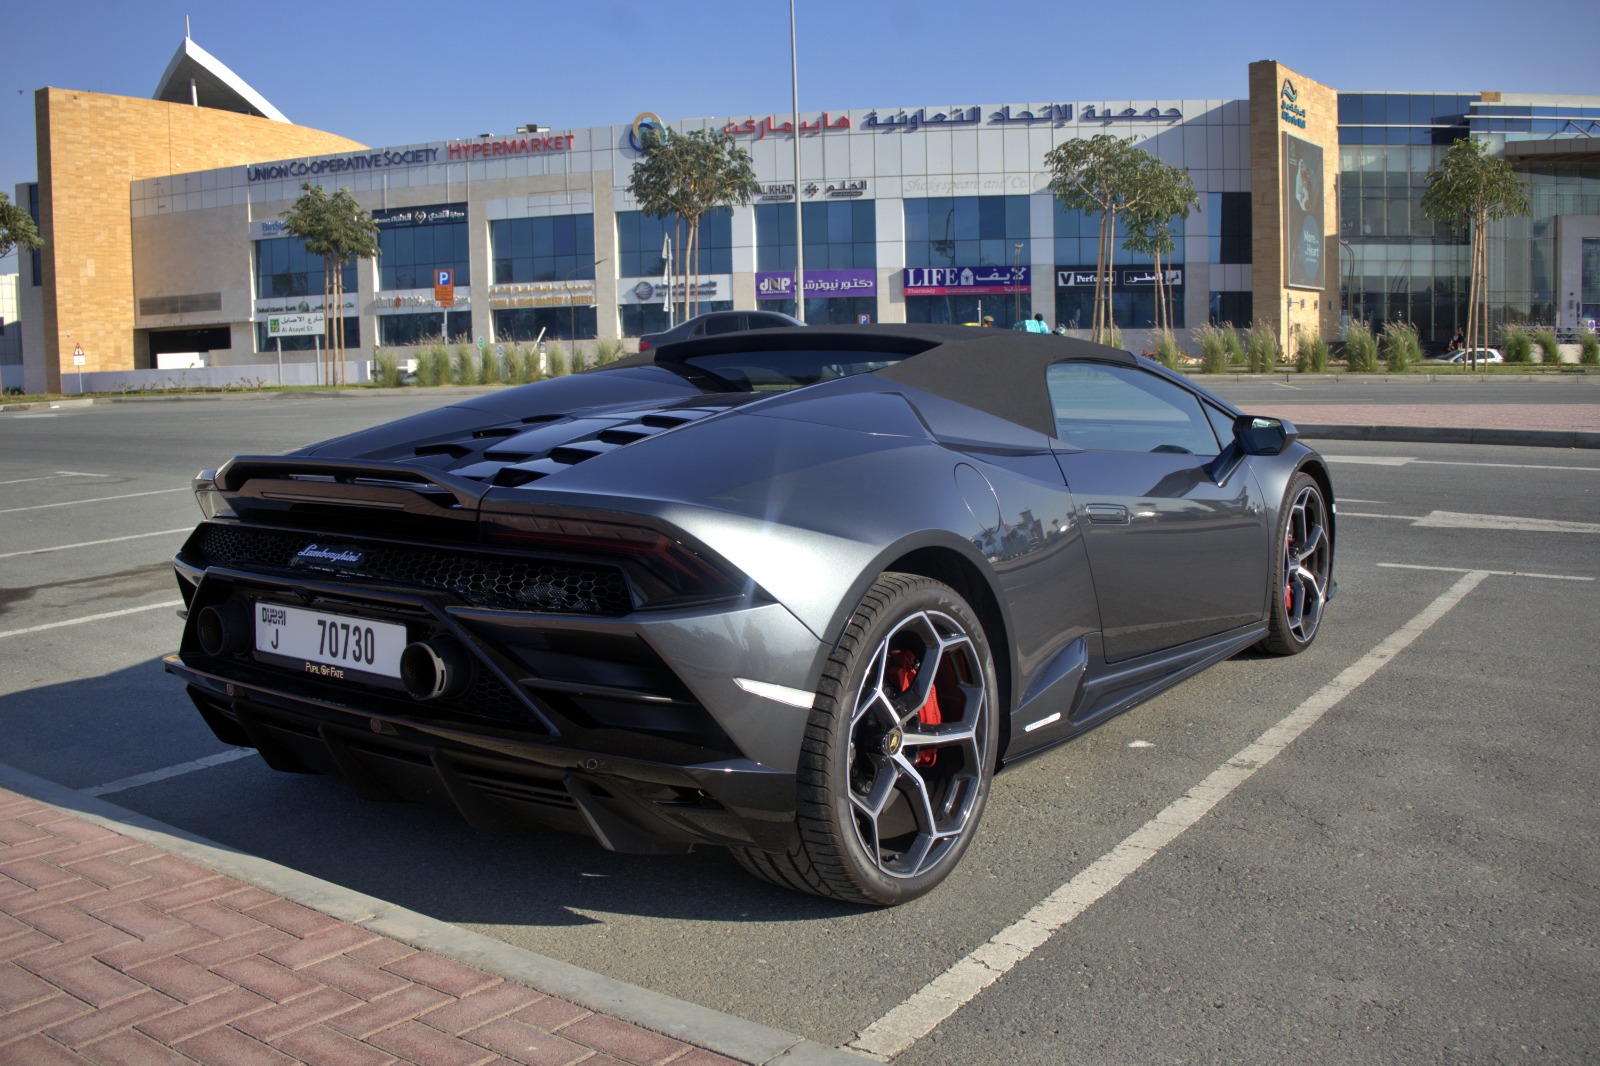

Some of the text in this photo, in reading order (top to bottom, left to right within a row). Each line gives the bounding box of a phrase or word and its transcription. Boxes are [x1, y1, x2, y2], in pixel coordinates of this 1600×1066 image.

[1085, 105, 1183, 126] جمعية
[247, 165, 289, 182] UNION
[383, 147, 439, 167] SOCIETY
[449, 134, 575, 161] HYPERMARKET
[440, 272, 449, 285] P
[908, 268, 959, 287] LIFE
[297, 543, 362, 563] Lamborghini
[271, 628, 279, 650] J
[317, 619, 375, 665] 70730
[330, 667, 345, 679] FATE
